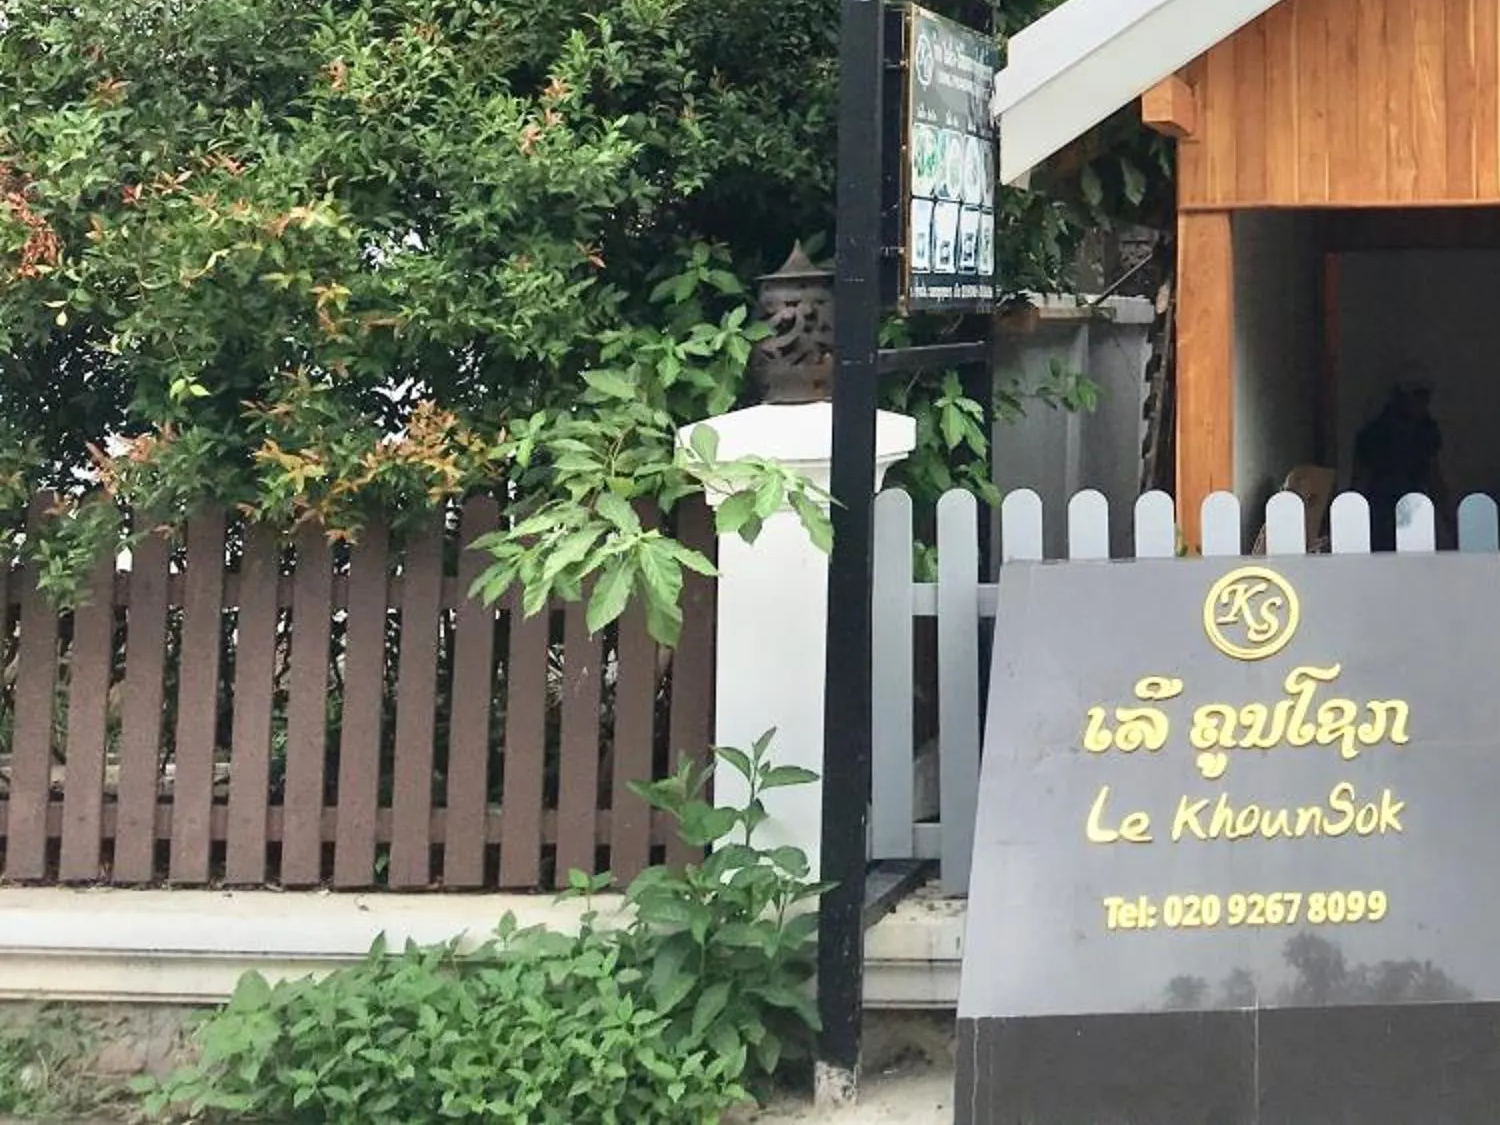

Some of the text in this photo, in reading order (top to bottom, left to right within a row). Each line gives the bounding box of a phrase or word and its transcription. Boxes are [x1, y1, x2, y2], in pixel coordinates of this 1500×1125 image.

[1215, 581, 1283, 643] KS
[1086, 780, 1406, 843] Le KhounSok
[1103, 890, 1388, 929] Tel: 020 9267 8099
